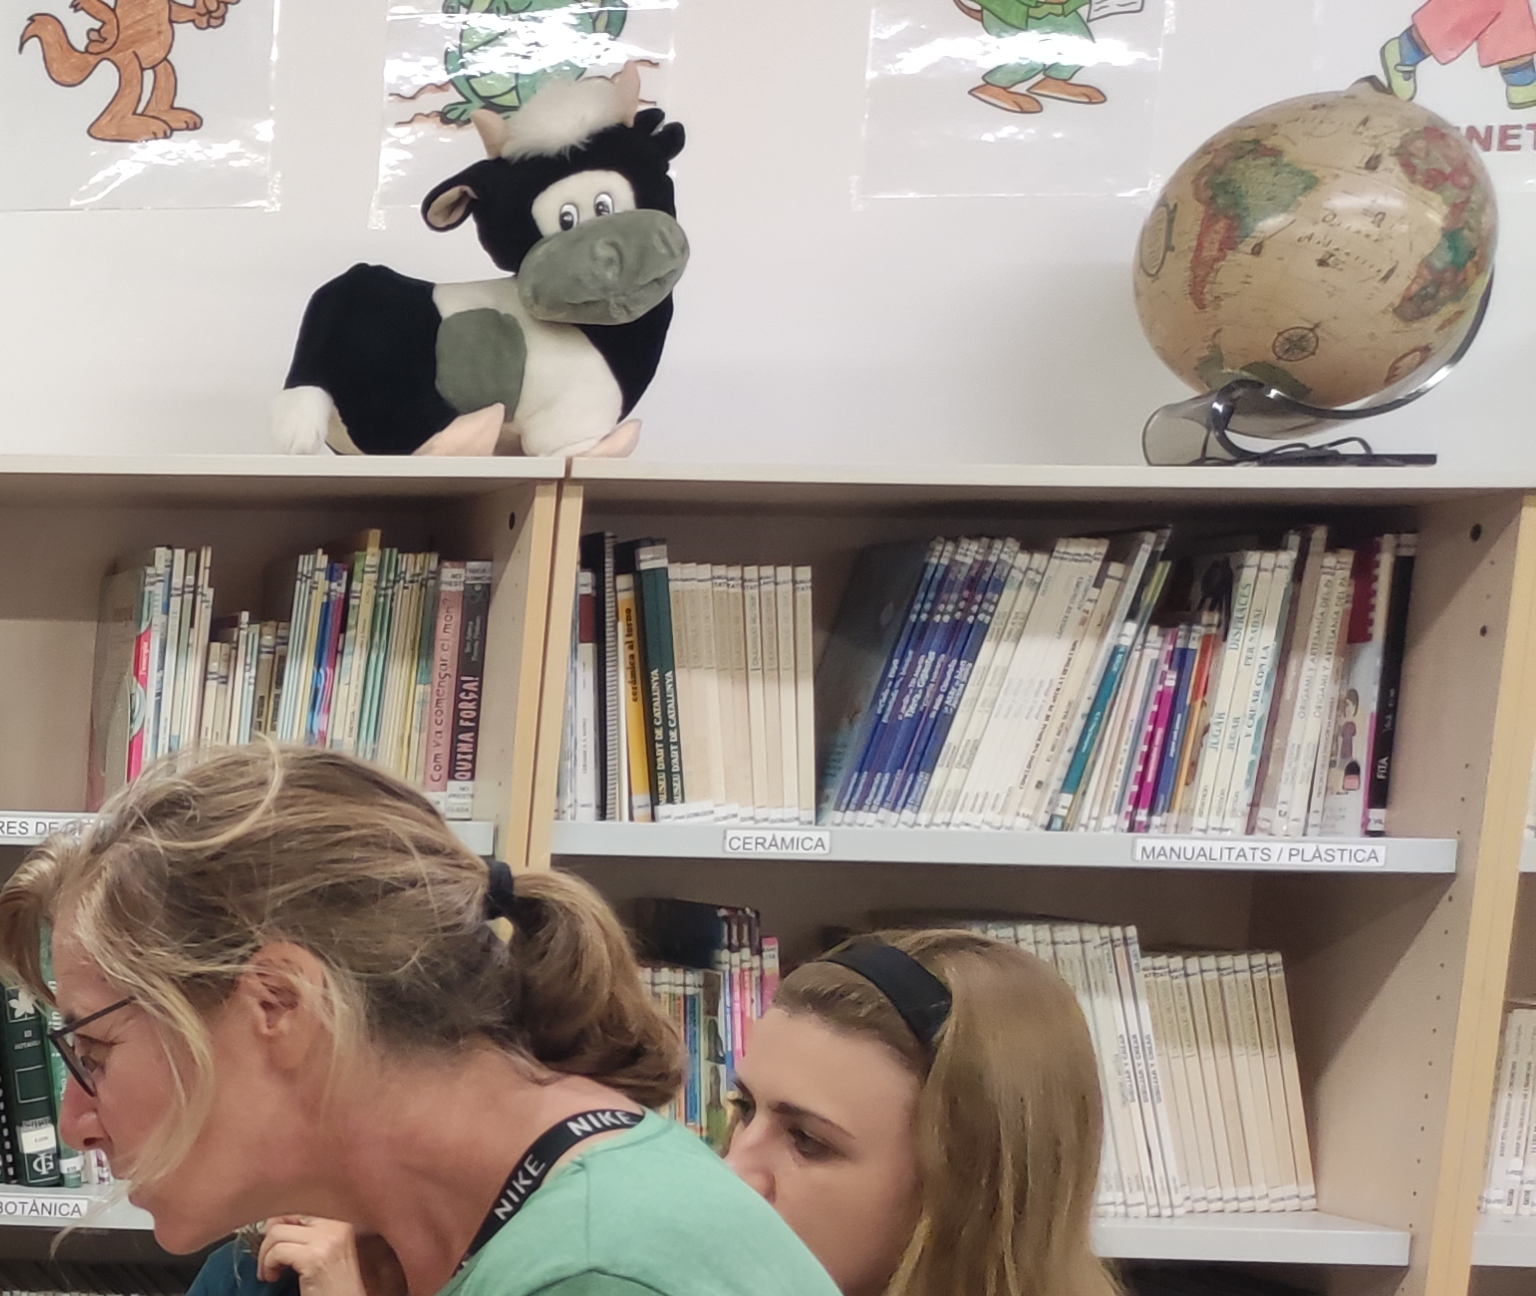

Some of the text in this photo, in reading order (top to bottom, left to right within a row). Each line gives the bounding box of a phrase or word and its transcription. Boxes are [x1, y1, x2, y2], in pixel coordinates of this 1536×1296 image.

[454, 675, 480, 780] QUINA FORÇA!
[1376, 756, 1389, 779] FITA
[729, 834, 826, 851] CERÀMICA
[1140, 845, 1271, 863] MANUALITATS
[1288, 844, 1379, 864] PLÀSTICA
[567, 1110, 637, 1137] NIKE
[493, 1153, 546, 1221] NIKE
